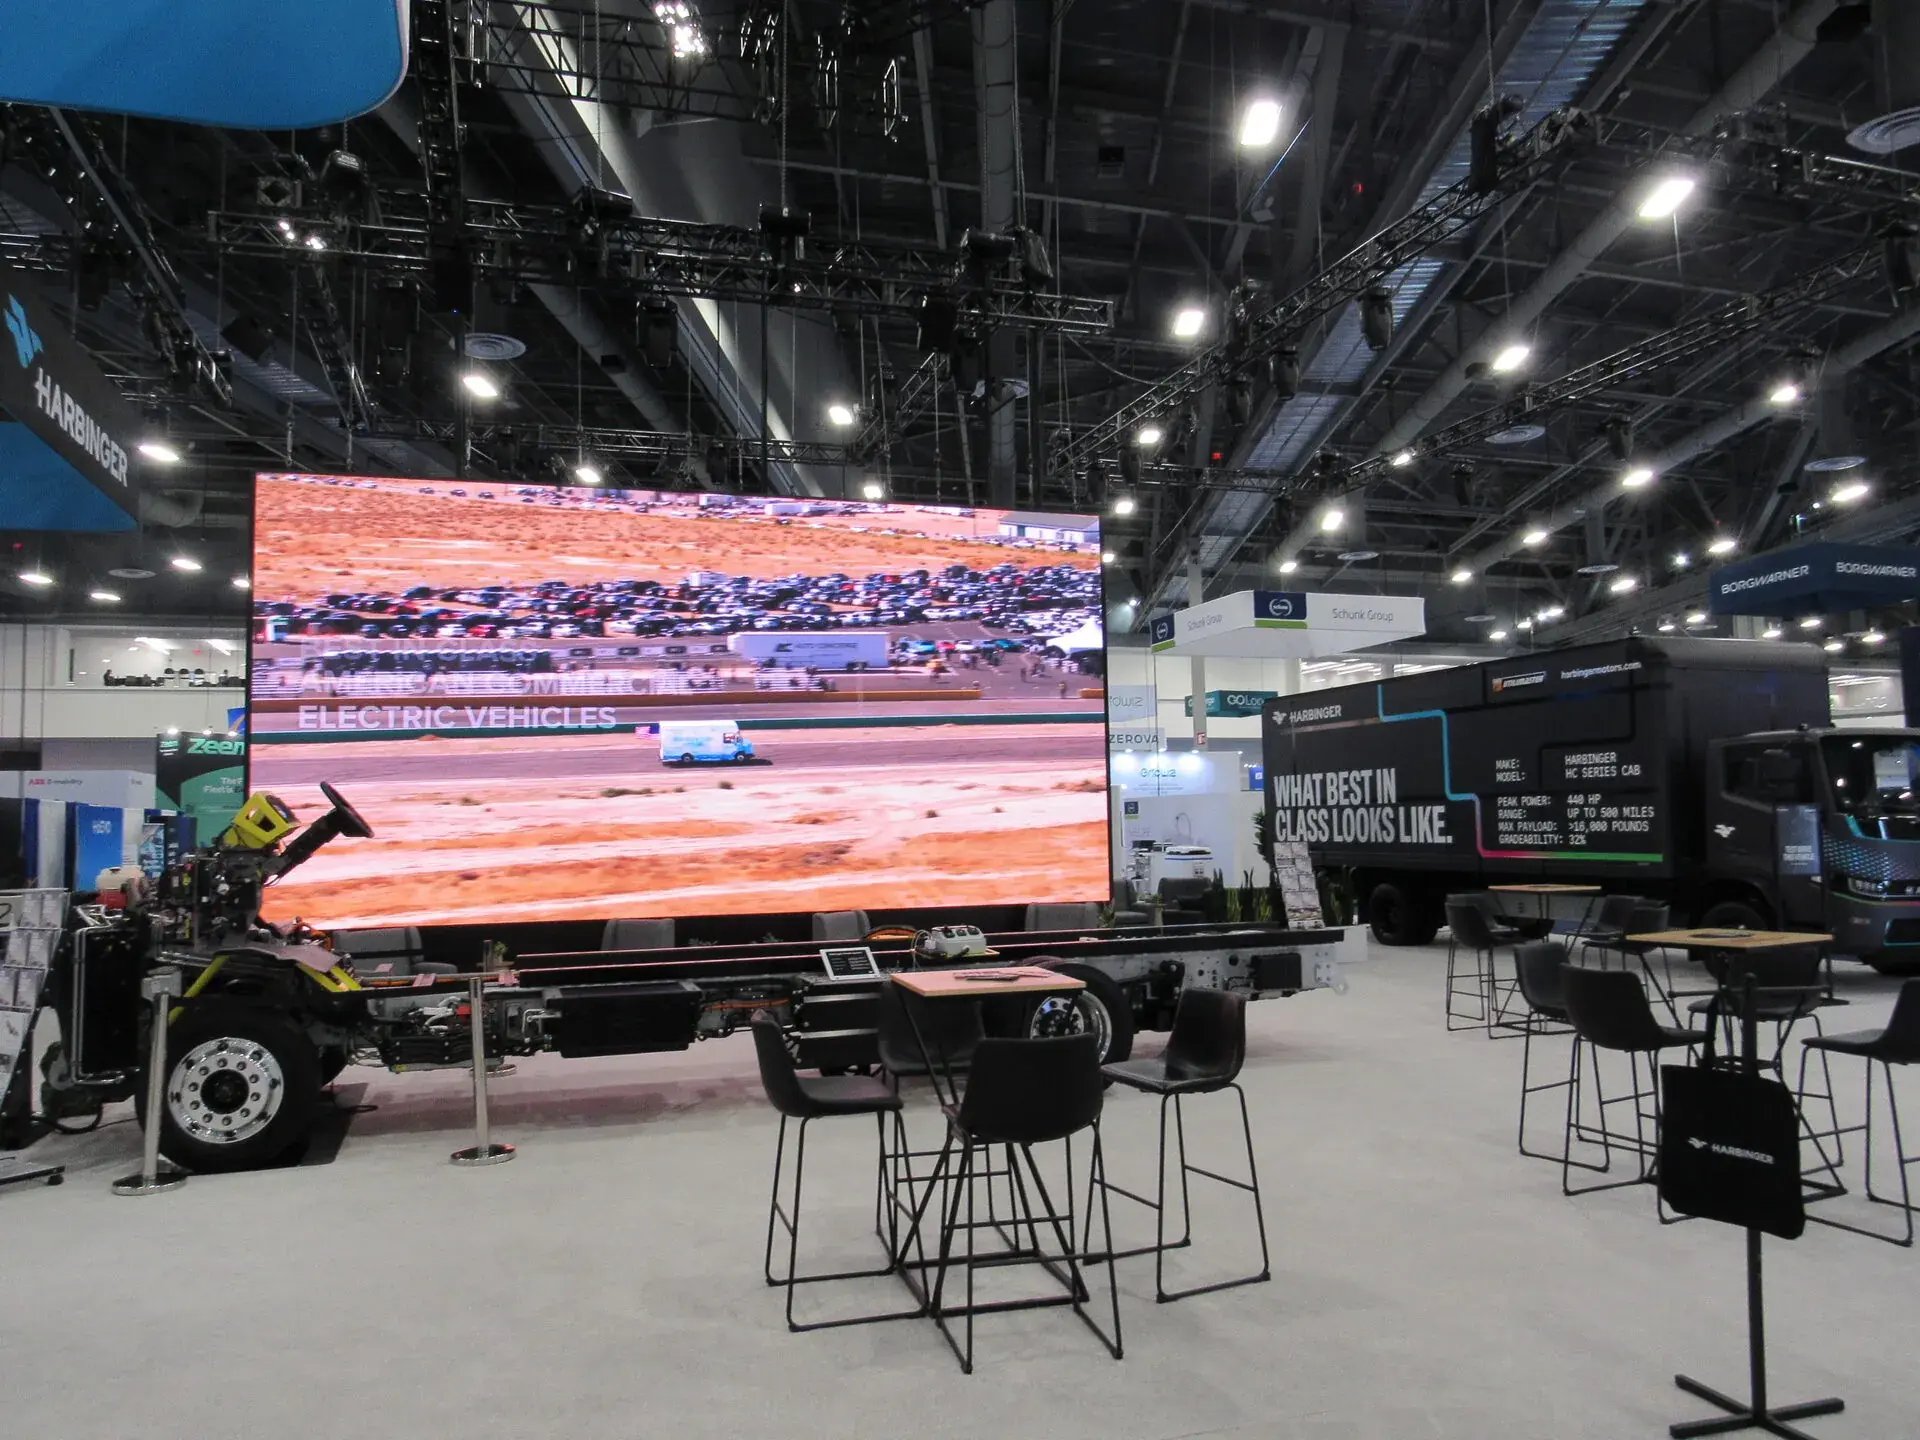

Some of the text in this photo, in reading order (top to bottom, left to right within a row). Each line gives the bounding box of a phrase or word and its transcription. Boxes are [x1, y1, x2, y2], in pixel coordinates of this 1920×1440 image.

[34, 366, 129, 488] HARBINGER
[1836, 561, 1917, 578] BORGWARNER
[1721, 565, 1810, 595] BORGWARNER
[1332, 608, 1394, 622] Schunk Group
[299, 705, 617, 729] ELECTRIC VEHICLES
[1289, 705, 1342, 723] HARBINGER
[1109, 734, 1158, 744] ZEROVA
[1496, 752, 1617, 770] MAKE: HARBINGER
[1496, 764, 1641, 782] MODEL: HC SERIES CAB
[1273, 767, 1397, 808] WHAT BEST IN
[1497, 794, 1602, 807] PEAK POWER: 440 HP
[1498, 806, 1655, 819] RANGE: UP TO 500 MILES
[1275, 805, 1453, 844] CLASS LOOKS LIKE.
[1498, 821, 1514, 832] MAX
[1517, 821, 1557, 832] PAYLOAD:
[1612, 820, 1650, 832] POUNDS
[1498, 834, 1587, 845] GRADEABILITY: 32%
[1711, 1143, 1775, 1165] HARBINGER
